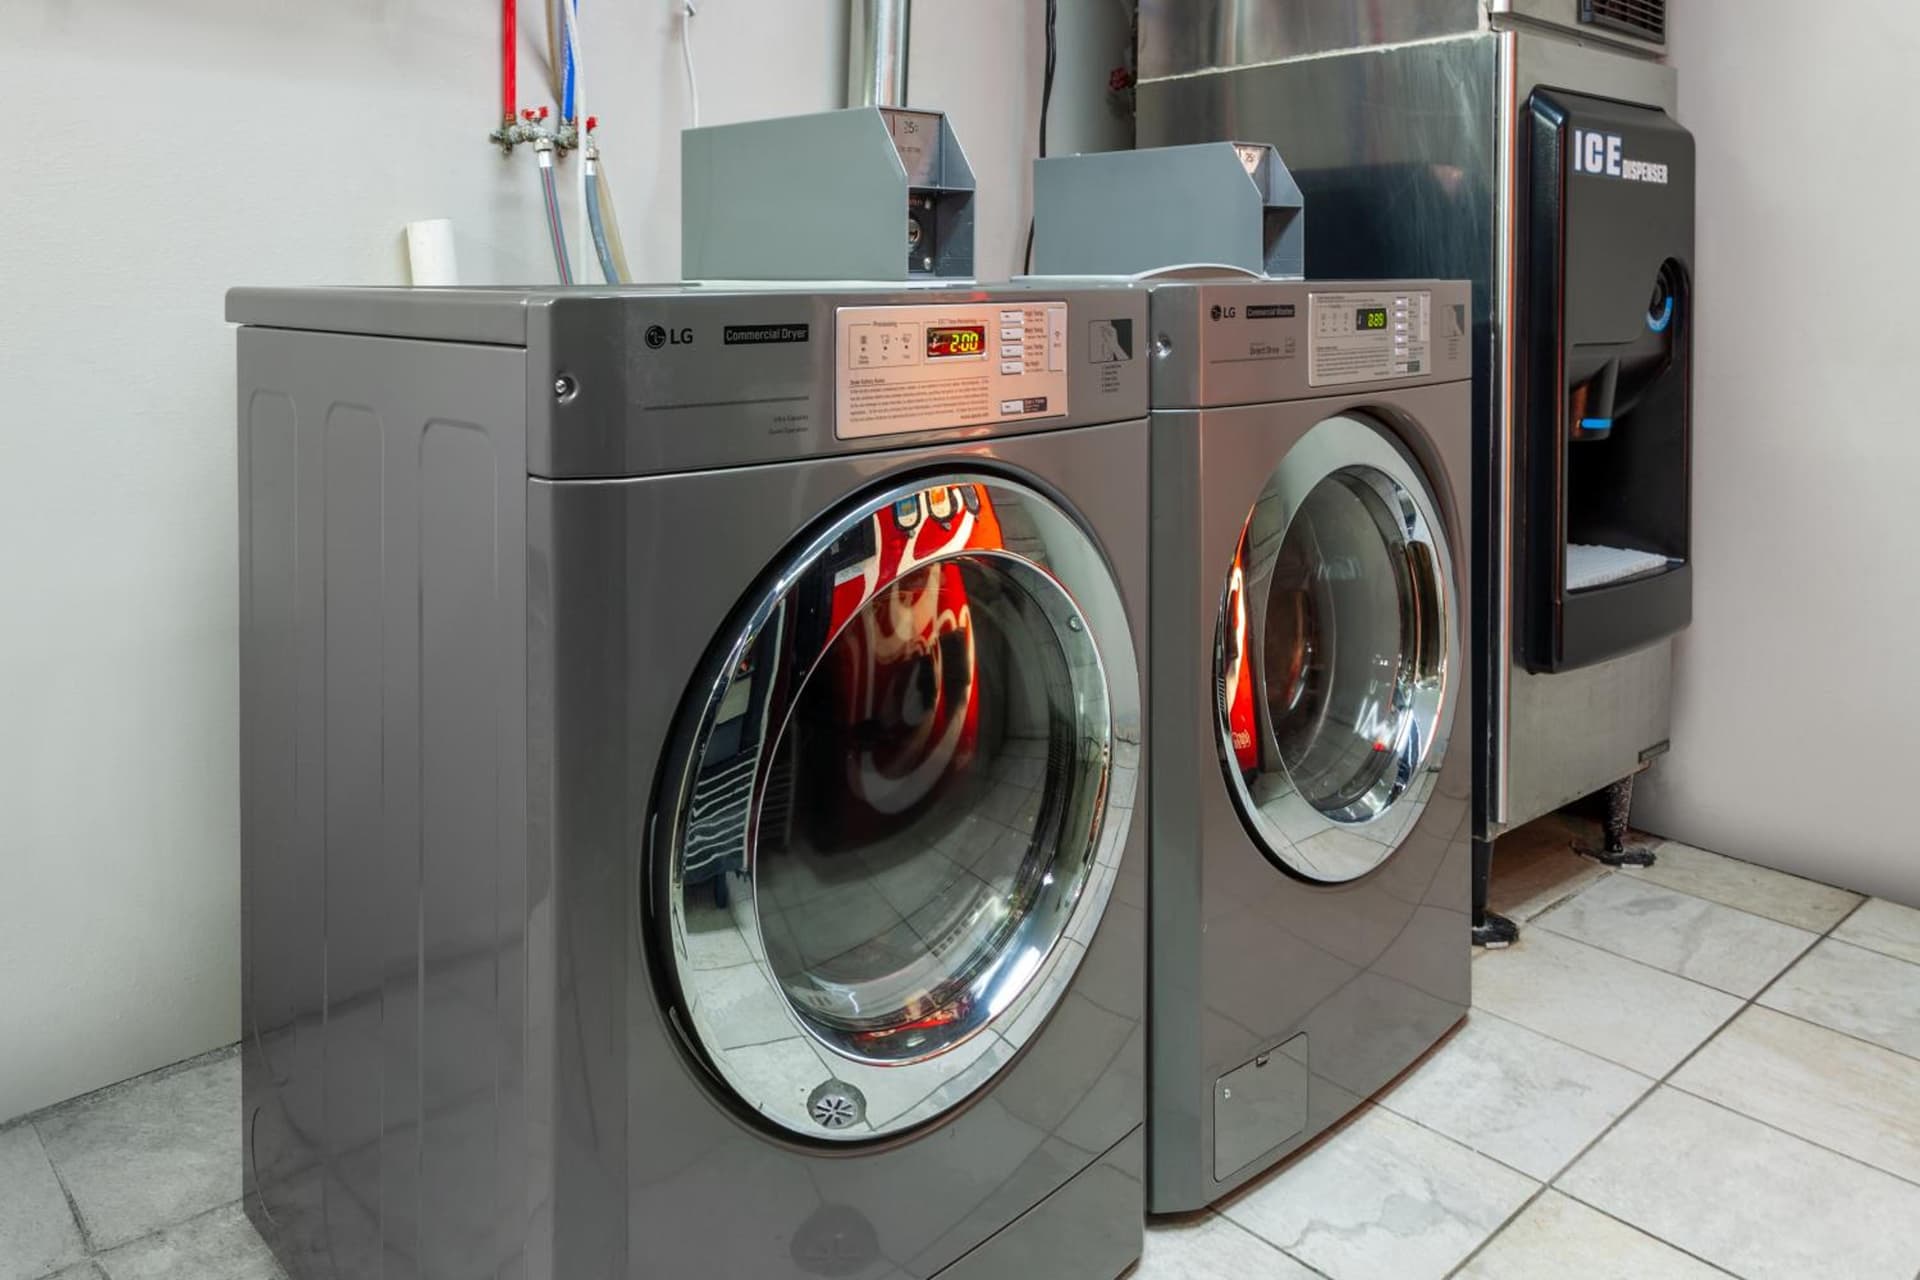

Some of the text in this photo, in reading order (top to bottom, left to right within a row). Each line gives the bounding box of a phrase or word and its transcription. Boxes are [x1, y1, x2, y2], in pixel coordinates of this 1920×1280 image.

[1574, 129, 1622, 176] ICE
[1622, 159, 1668, 184] DISPENSER
[1223, 307, 1236, 318] LG
[670, 328, 694, 345] LG
[726, 327, 808, 342] Commercial Dryer
